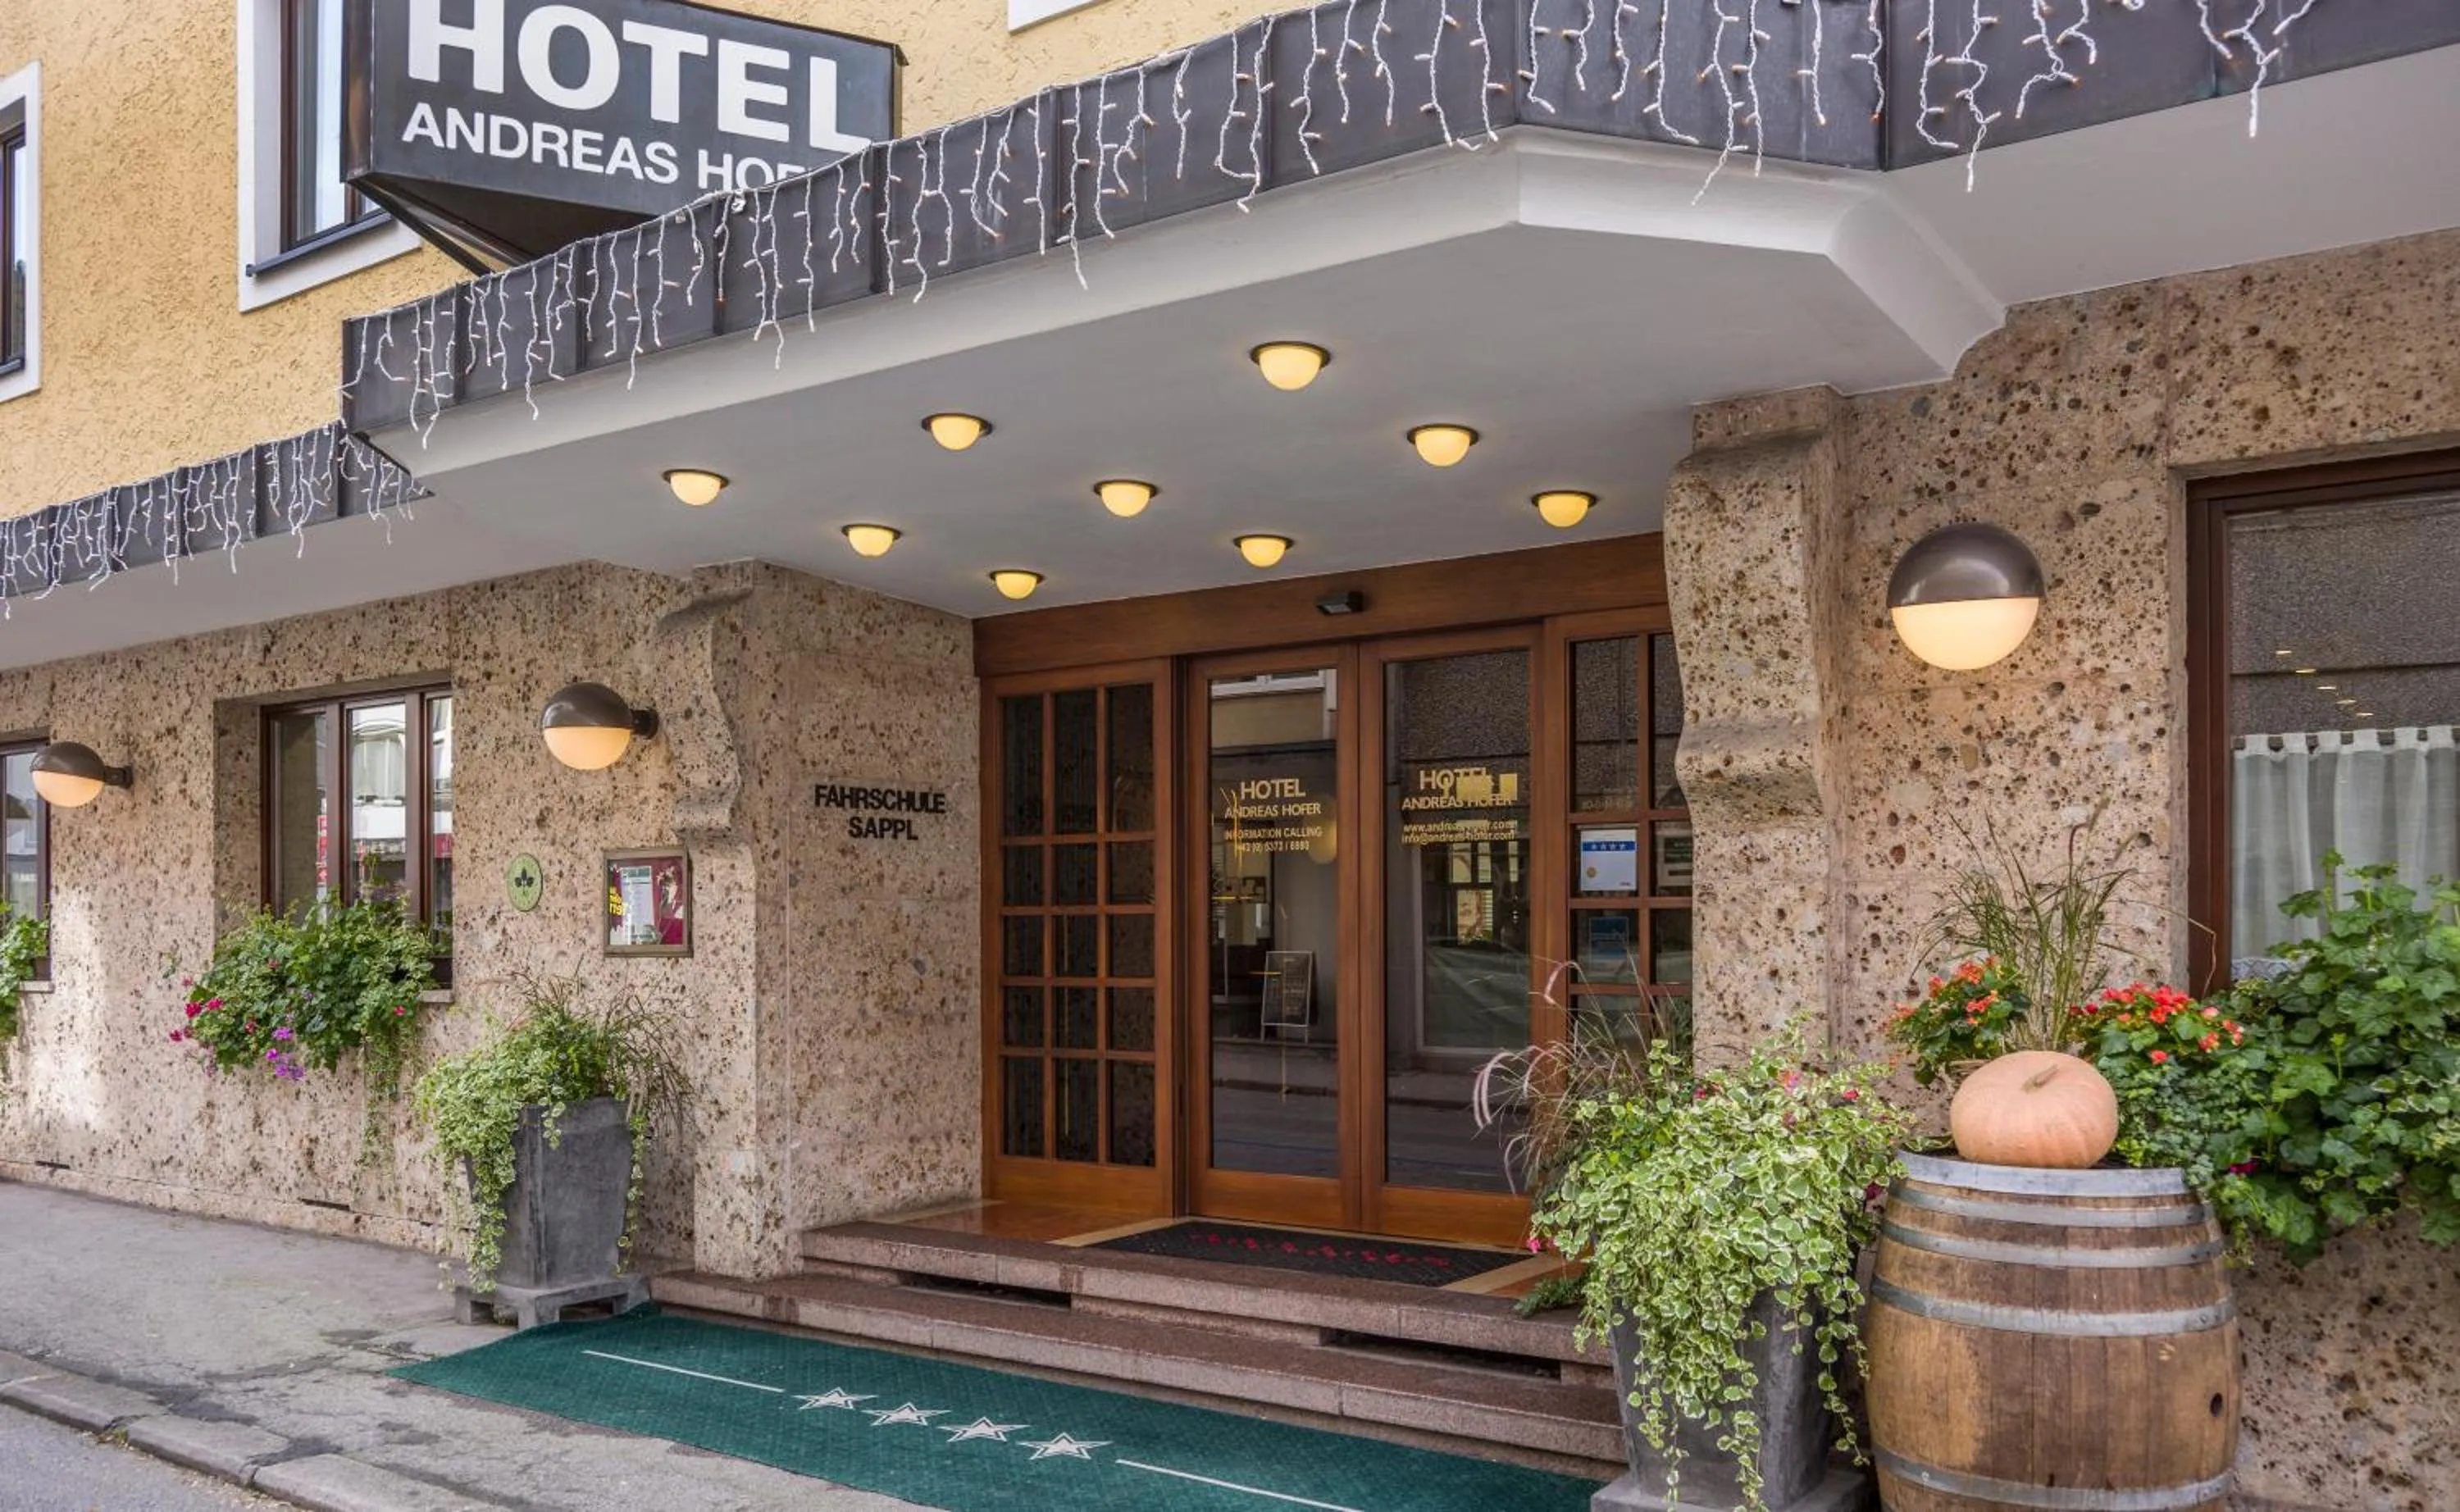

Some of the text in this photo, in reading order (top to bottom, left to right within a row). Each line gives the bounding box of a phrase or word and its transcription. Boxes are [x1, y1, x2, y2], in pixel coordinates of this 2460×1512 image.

[408, 0, 871, 153] HOTEL
[402, 102, 680, 185] ANDREAS
[1240, 778, 1306, 800] HOTEL
[1419, 767, 1493, 790] HOTEL
[814, 784, 945, 814] FAHRSCHULE
[1224, 802, 1321, 819] ANDREAS HOFER
[1401, 796, 1464, 811] ANDREAS
[848, 816, 918, 840] SAPPL
[1283, 826, 1323, 838] CALLING
